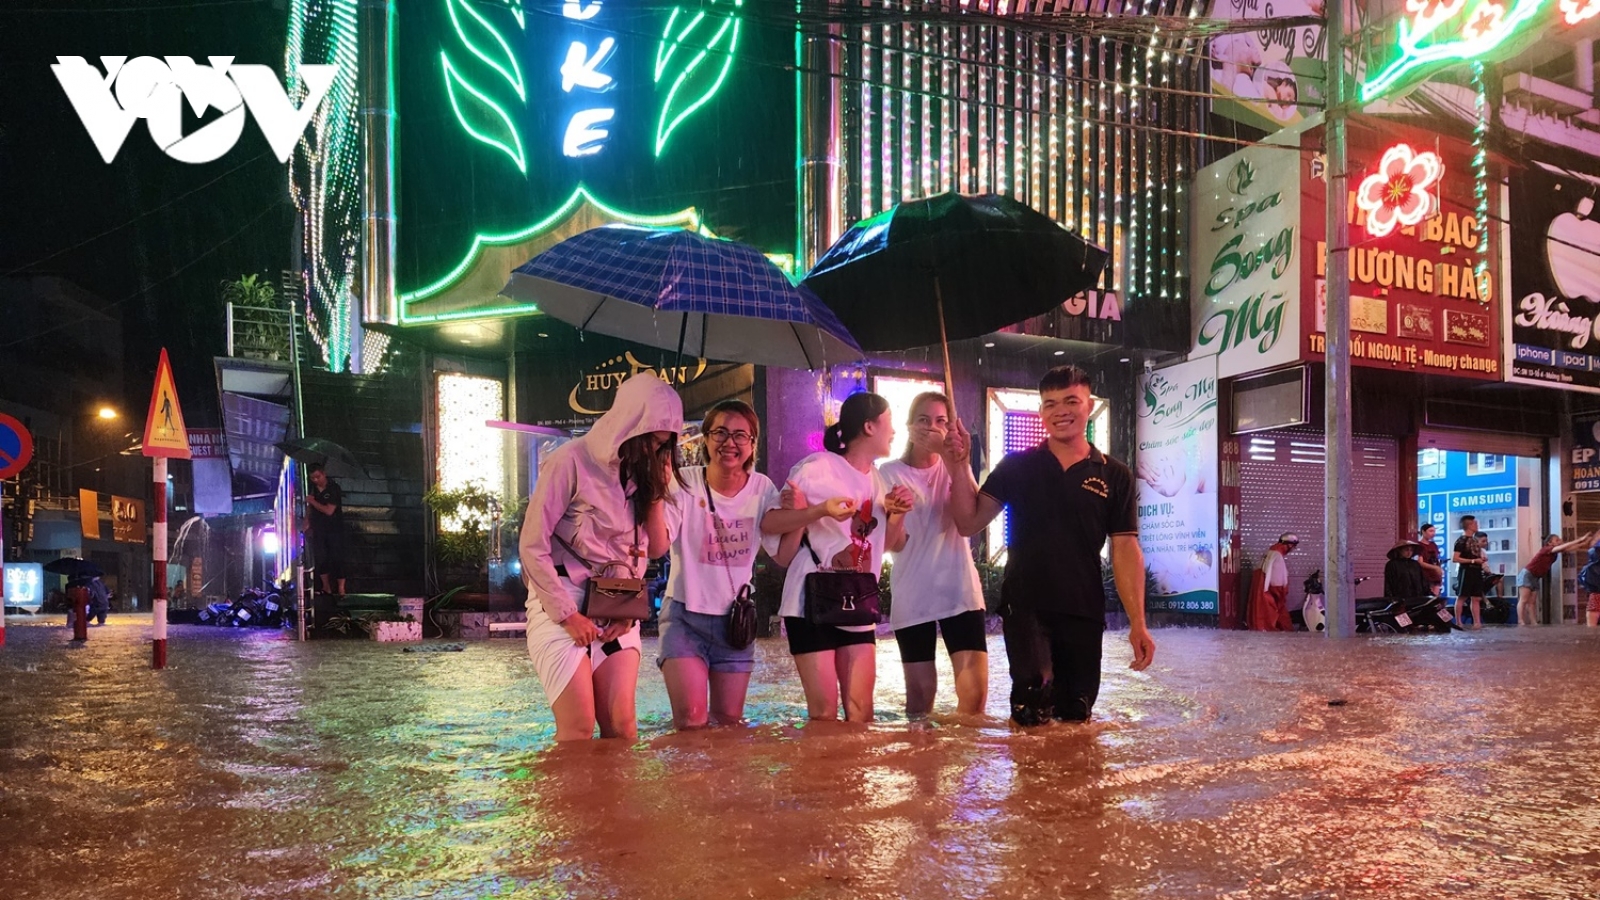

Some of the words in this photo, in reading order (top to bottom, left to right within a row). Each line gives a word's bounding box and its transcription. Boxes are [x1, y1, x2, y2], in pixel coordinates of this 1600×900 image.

[1426, 211, 1479, 254] BẠC
[1204, 225, 1295, 297] Song
[1442, 258, 1494, 303] HÀO
[1062, 290, 1121, 321] GIA
[1198, 291, 1287, 356] Mỹ
[1368, 342, 1401, 365] NGOẠI
[1405, 344, 1417, 368] TỆ
[1424, 350, 1458, 370] Money
[1460, 354, 1497, 373] change
[1518, 345, 1549, 360] iphone
[1563, 353, 1586, 366] ipad
[586, 372, 627, 391] HUY
[1160, 381, 1178, 397] Spa
[1223, 441, 1239, 454] 888
[1453, 492, 1513, 507] SAMSUNG
[1168, 601, 1185, 609] 0912
[1186, 601, 1199, 610] 806
[1200, 601, 1214, 610] 380
